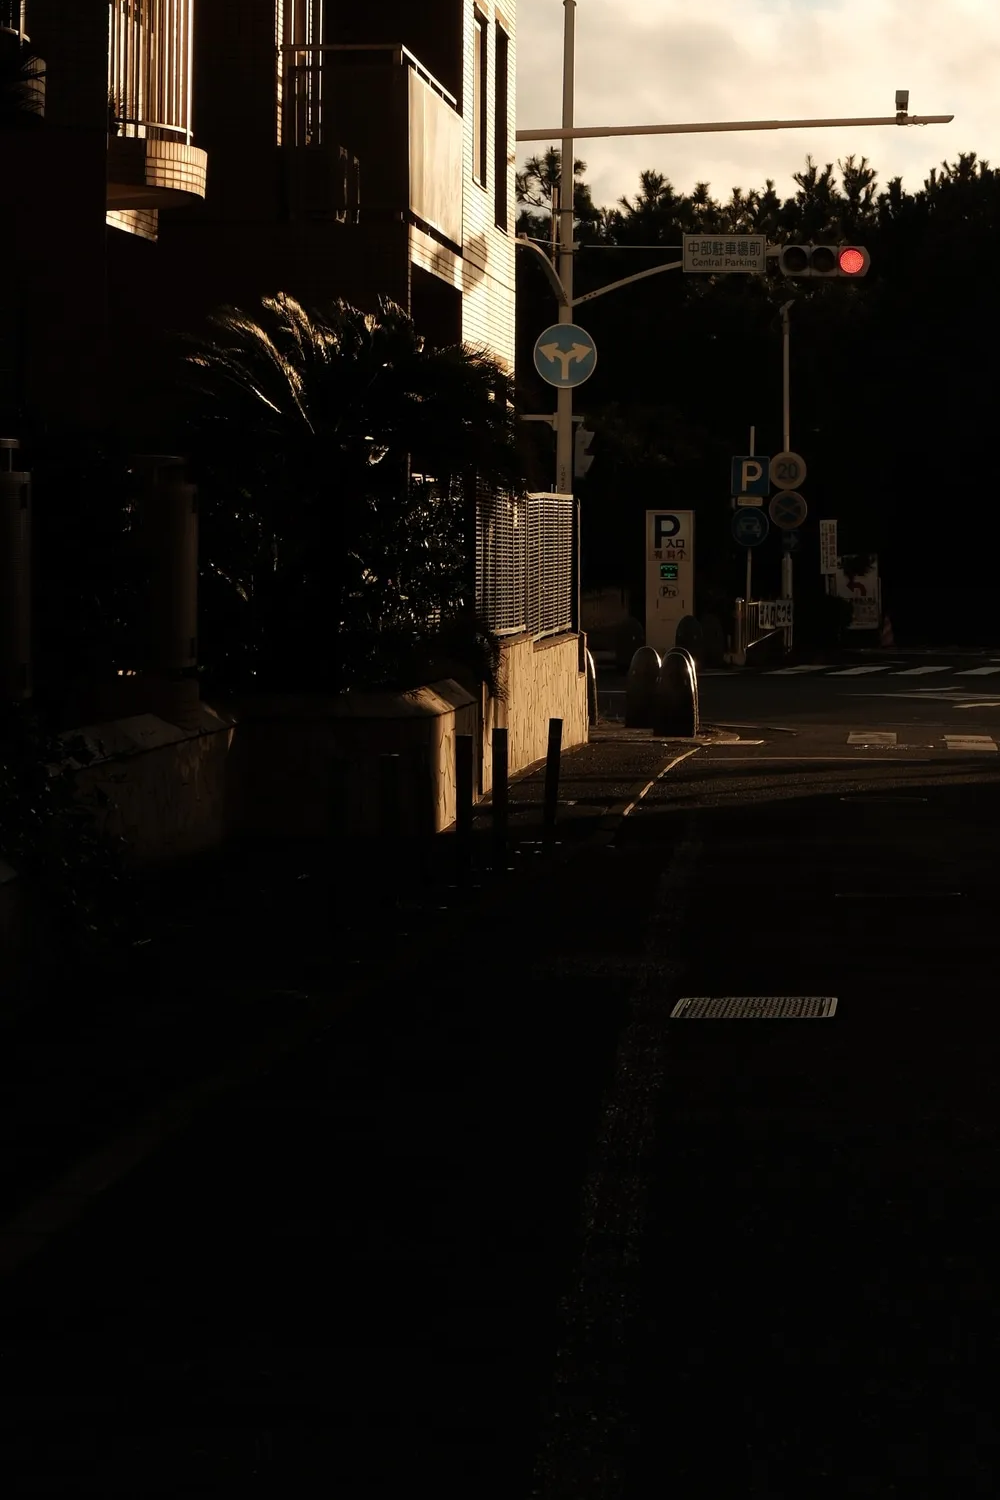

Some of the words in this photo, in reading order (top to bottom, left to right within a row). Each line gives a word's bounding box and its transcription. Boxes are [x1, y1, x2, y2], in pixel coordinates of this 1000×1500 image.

[688, 241, 761, 256] 中部駐車場前
[692, 258, 722, 267] Central
[725, 258, 757, 268] Parking
[741, 460, 763, 493] P
[777, 462, 798, 480] 20
[655, 515, 680, 549] P
[666, 539, 685, 549] 入口
